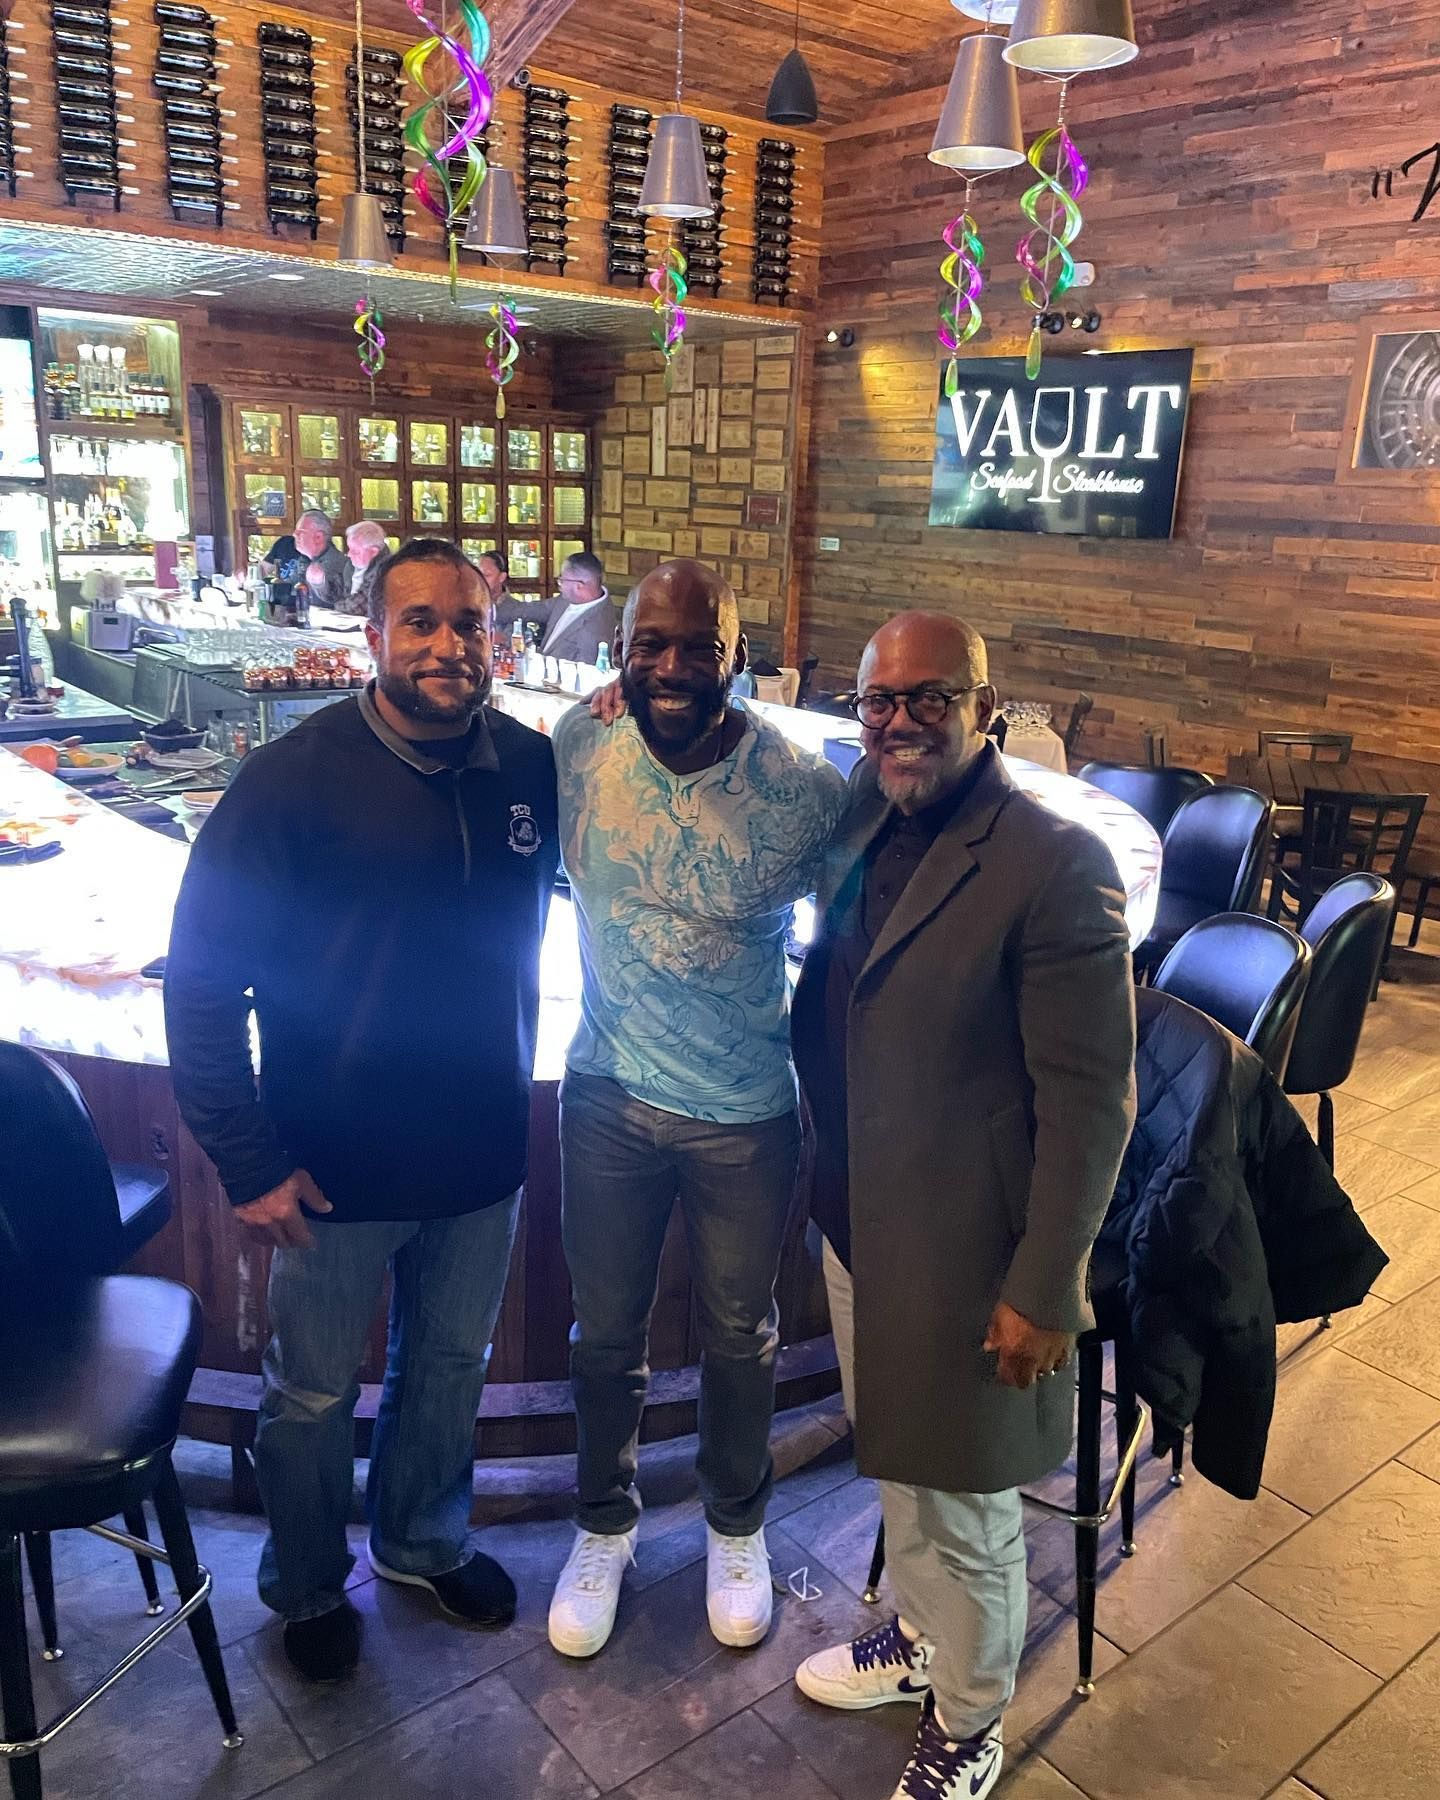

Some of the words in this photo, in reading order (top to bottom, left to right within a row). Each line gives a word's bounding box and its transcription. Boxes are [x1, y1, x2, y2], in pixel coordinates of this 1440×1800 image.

[950, 385, 1181, 459] VAULT
[970, 462, 1037, 498] Seafood
[1052, 464, 1145, 494] Steakhouse
